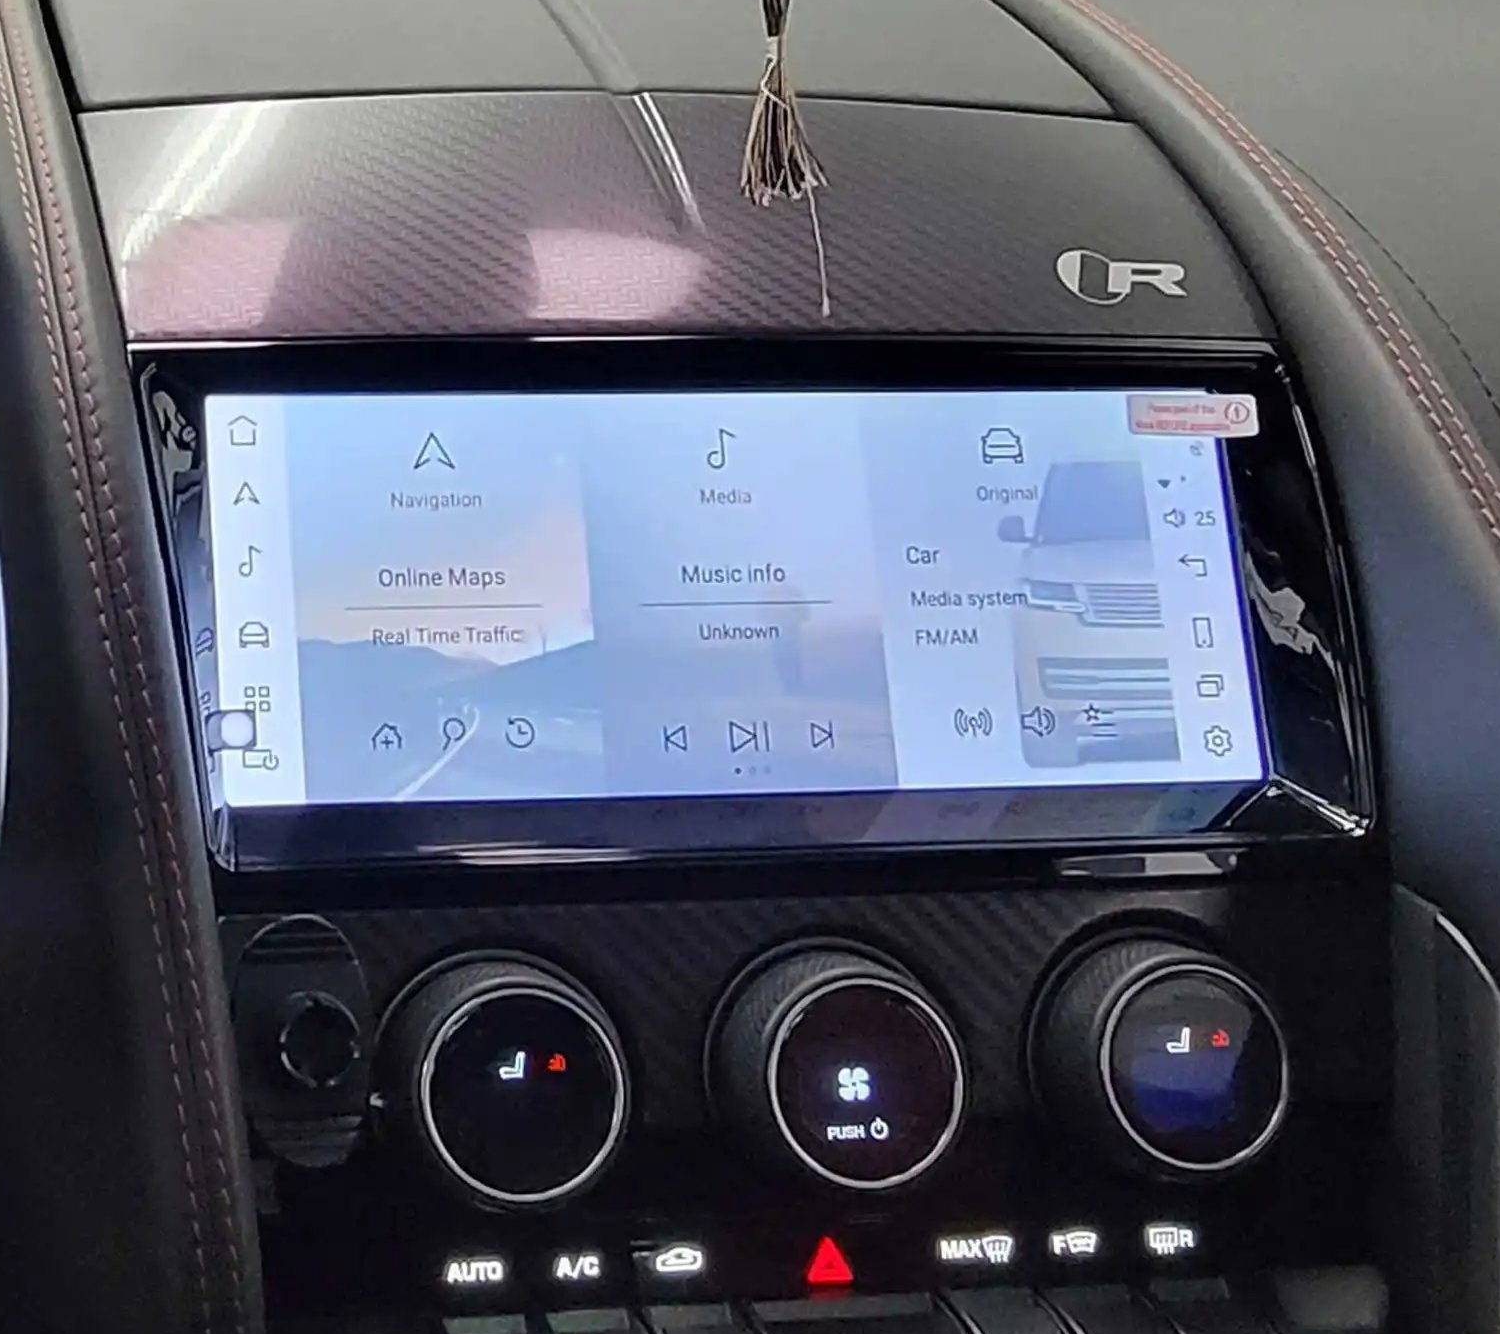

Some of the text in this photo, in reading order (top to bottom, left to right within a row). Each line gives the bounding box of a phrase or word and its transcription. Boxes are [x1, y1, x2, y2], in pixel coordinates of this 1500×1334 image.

[390, 491, 482, 512] Navigation
[700, 487, 752, 505] Media
[977, 485, 1039, 504] Original
[1195, 511, 1217, 527] 25
[906, 547, 940, 566] Car
[378, 568, 507, 591] Online Maps
[681, 565, 786, 584] Music info
[911, 591, 1029, 610] Media system
[372, 626, 522, 645] Real Time Traffic
[699, 623, 780, 642] Unknown
[915, 629, 979, 647] FM/AM
[826, 1124, 866, 1141] PUSH
[1052, 1234, 1067, 1255] F
[1178, 1229, 1195, 1248] R
[939, 1238, 983, 1259] MAX
[447, 1260, 504, 1283] AUTO
[556, 1255, 600, 1279] A/C
